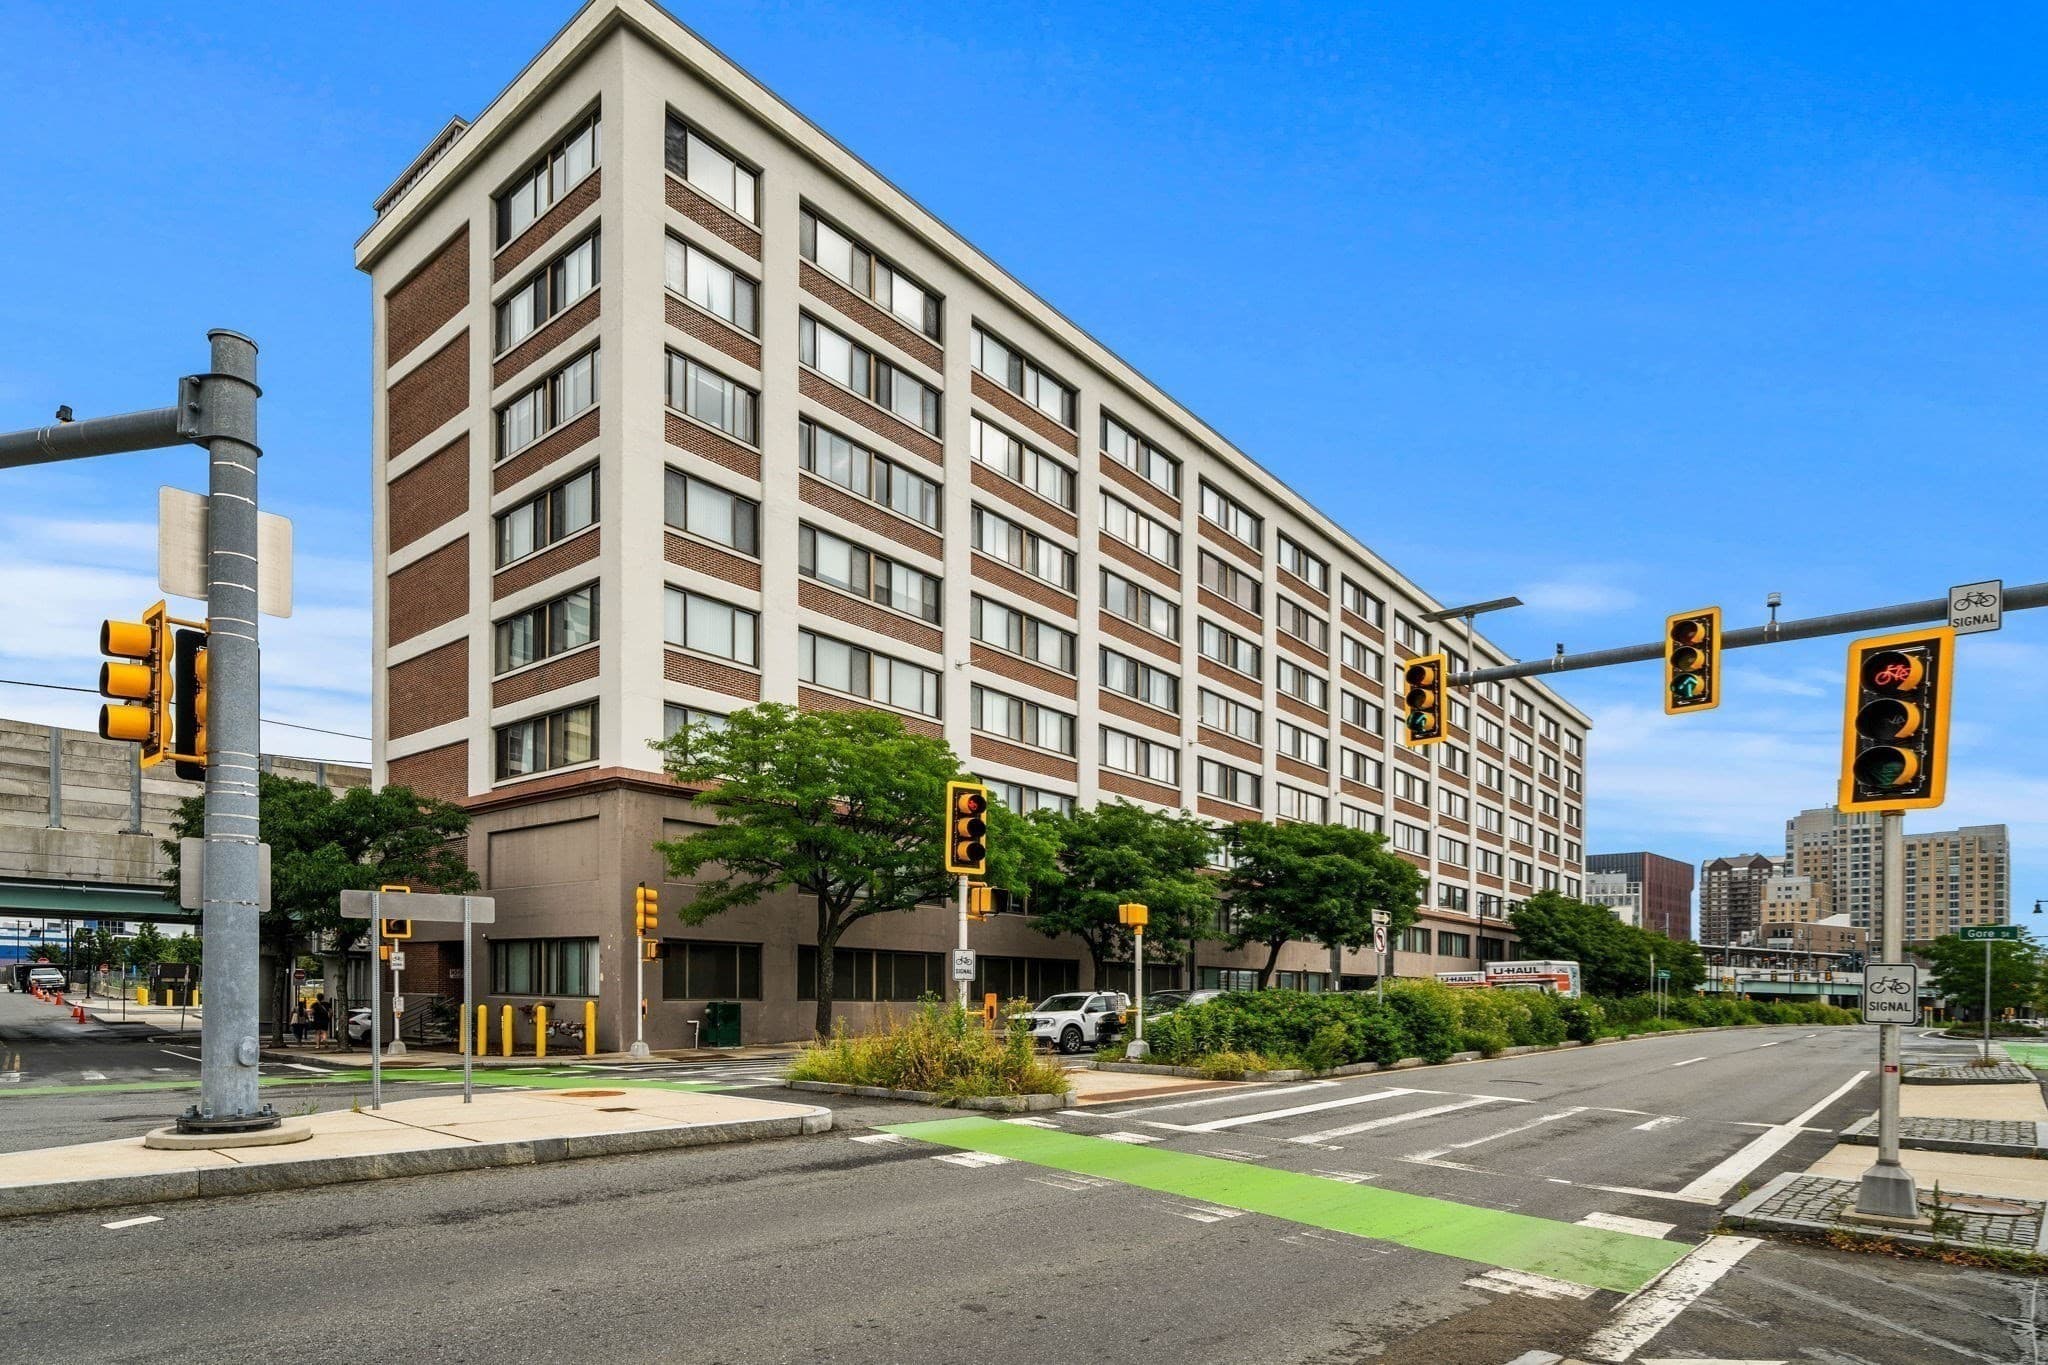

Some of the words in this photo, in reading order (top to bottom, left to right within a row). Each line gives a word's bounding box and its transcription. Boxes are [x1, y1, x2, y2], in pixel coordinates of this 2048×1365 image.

[1952, 613, 1997, 628] SIGNAL
[1967, 929, 1995, 938] Gore
[1493, 966, 1541, 975] U-HAUL
[1868, 1001, 1912, 1012] SIGNAL
